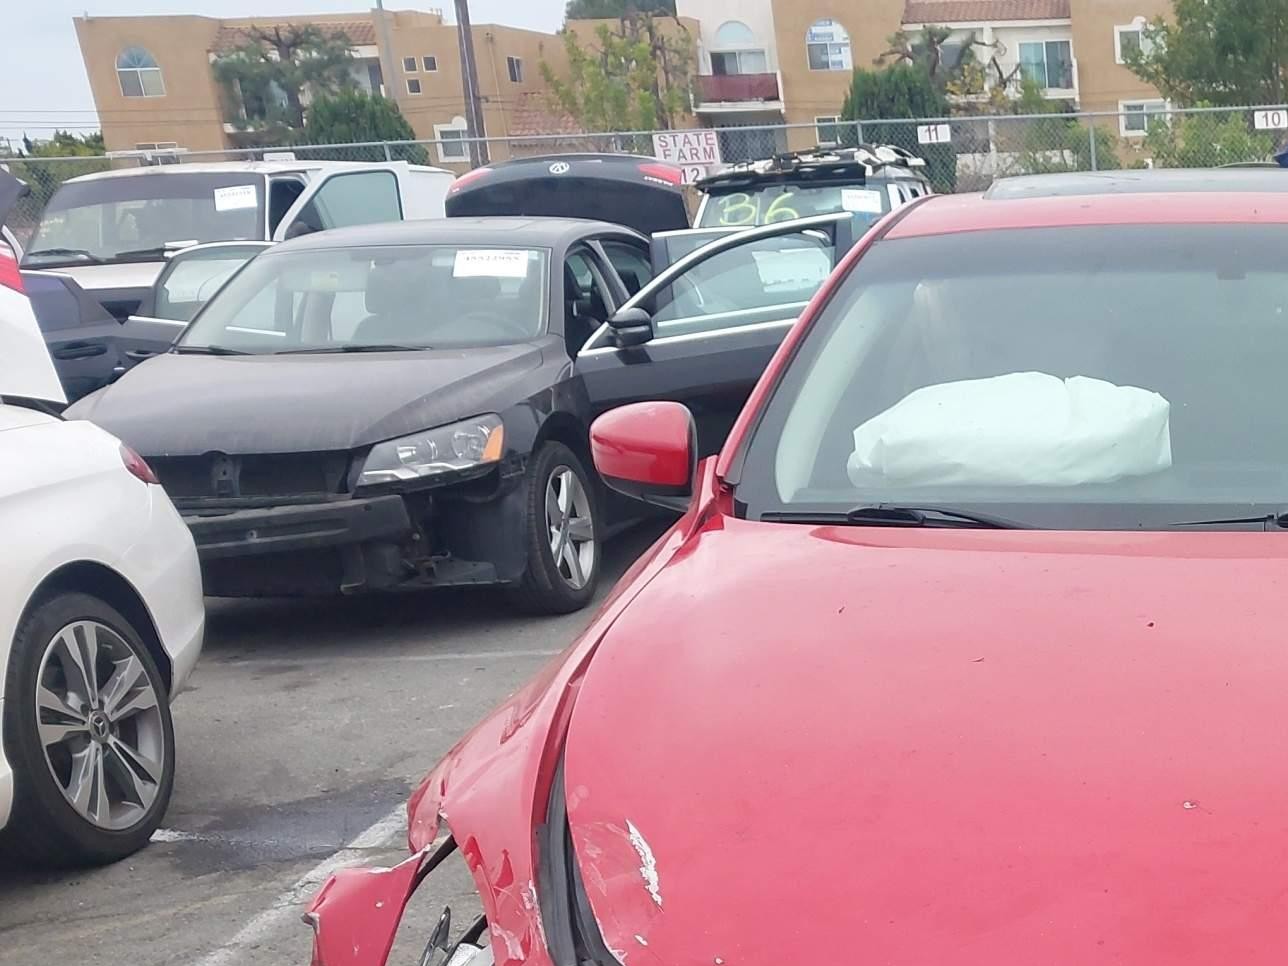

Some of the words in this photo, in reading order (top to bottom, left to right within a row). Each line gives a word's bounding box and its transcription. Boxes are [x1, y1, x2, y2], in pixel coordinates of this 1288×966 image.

[1262, 111, 1281, 127] 10
[657, 132, 715, 148] STATE
[924, 125, 939, 142] 11
[662, 147, 715, 161] FARM
[680, 167, 700, 184] 12
